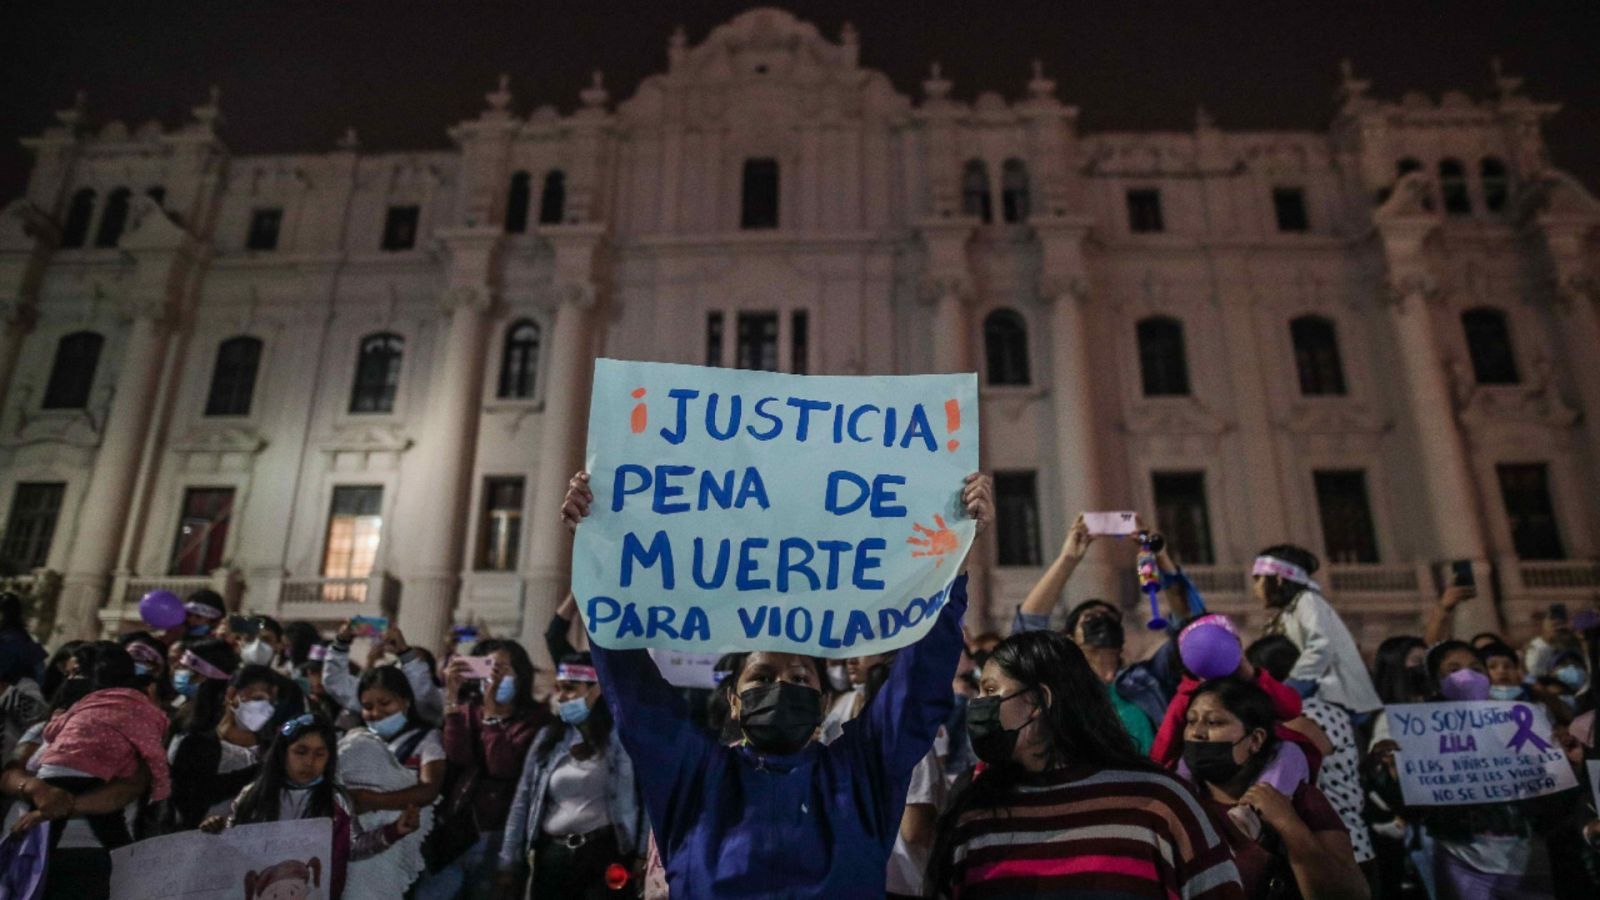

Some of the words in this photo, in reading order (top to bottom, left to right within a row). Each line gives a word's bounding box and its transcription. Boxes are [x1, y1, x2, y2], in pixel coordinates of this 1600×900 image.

[611, 464, 770, 515] PENA
[824, 470, 907, 518] DE
[619, 529, 886, 593] MUERTE
[587, 596, 711, 641] PARA
[1393, 712, 1426, 736] YO
[1431, 709, 1466, 732] SOY
[1405, 759, 1417, 775] A
[1418, 759, 1444, 774] LAS
[1493, 756, 1512, 767] NO
[1516, 754, 1532, 765] SE
[1538, 751, 1563, 763] LES
[1482, 770, 1504, 782] LES
[1432, 788, 1454, 802] NO
[1457, 788, 1477, 801] SE
[1483, 785, 1512, 798] LES
